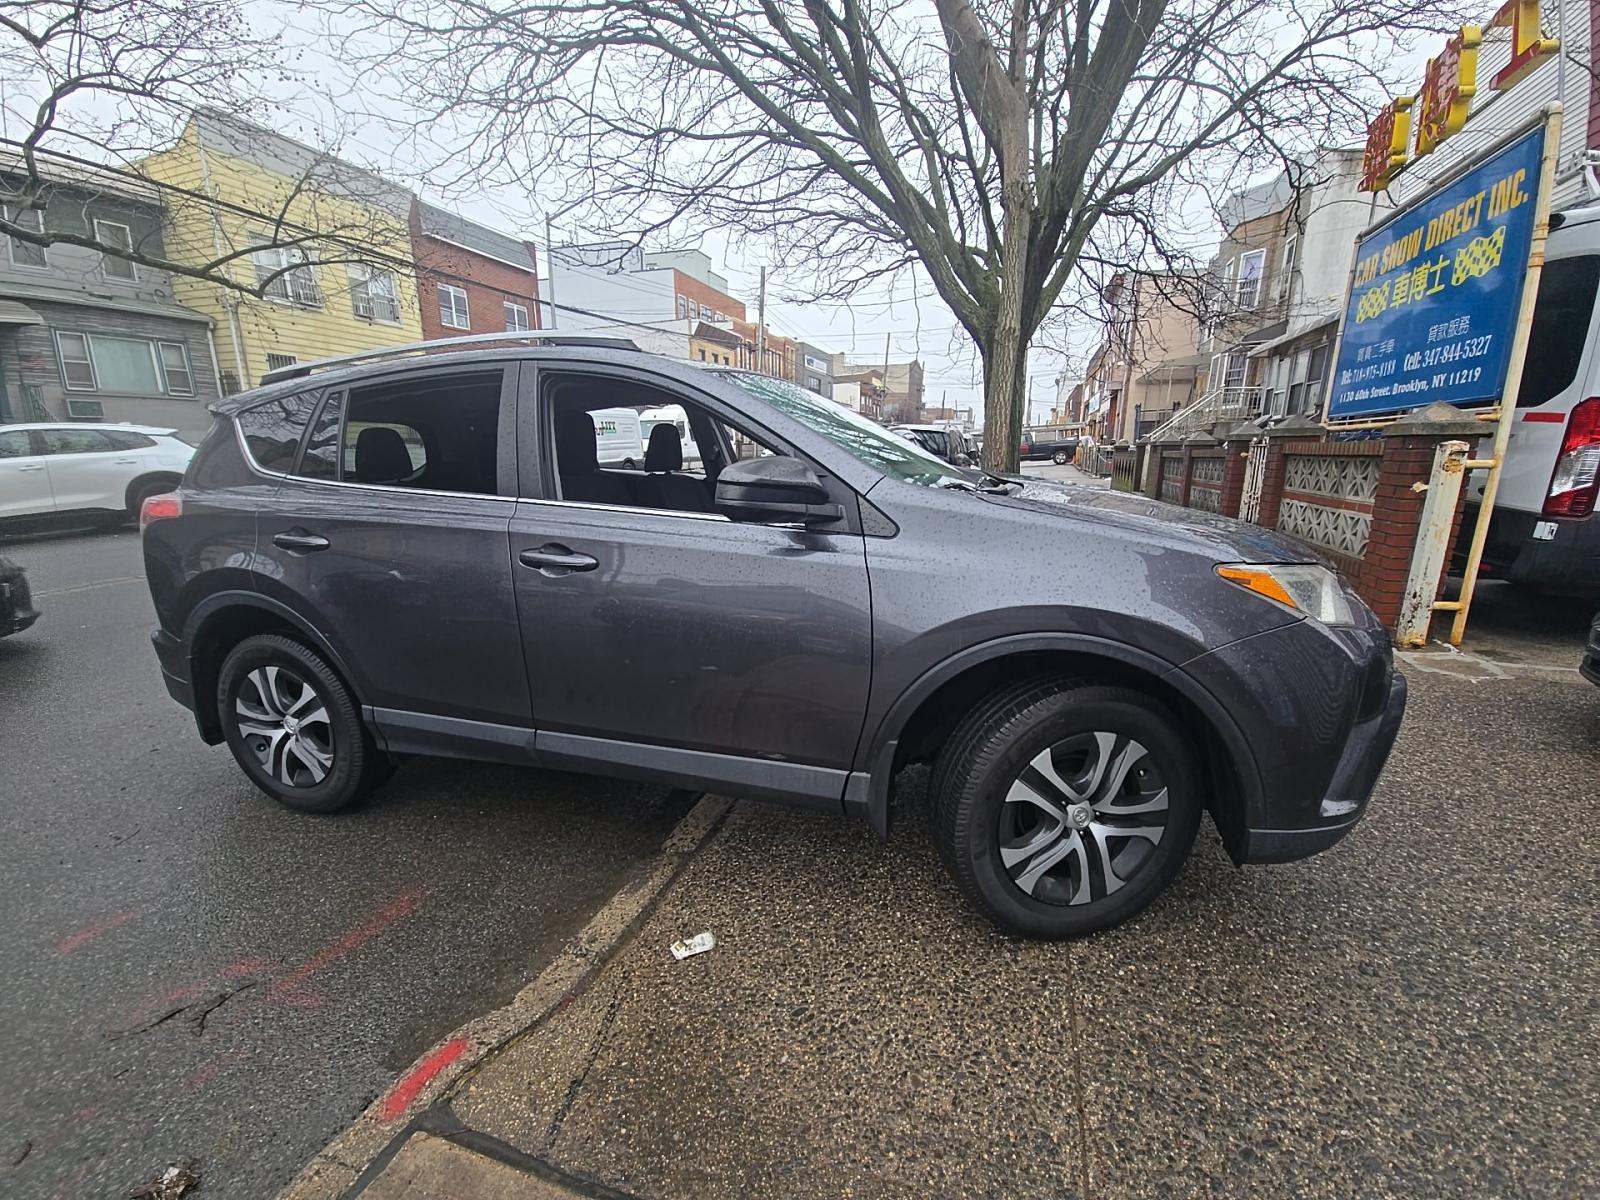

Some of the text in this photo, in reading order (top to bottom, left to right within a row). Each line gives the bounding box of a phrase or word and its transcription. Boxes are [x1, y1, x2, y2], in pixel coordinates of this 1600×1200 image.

[1354, 168, 1528, 288] CAR SHOW DIRECT INC.
[1389, 254, 1451, 309] 車博士
[1404, 335, 1492, 372] Cell: 347-844-5327
[1431, 373, 1447, 388] NY
[1449, 367, 1481, 386] 11219
